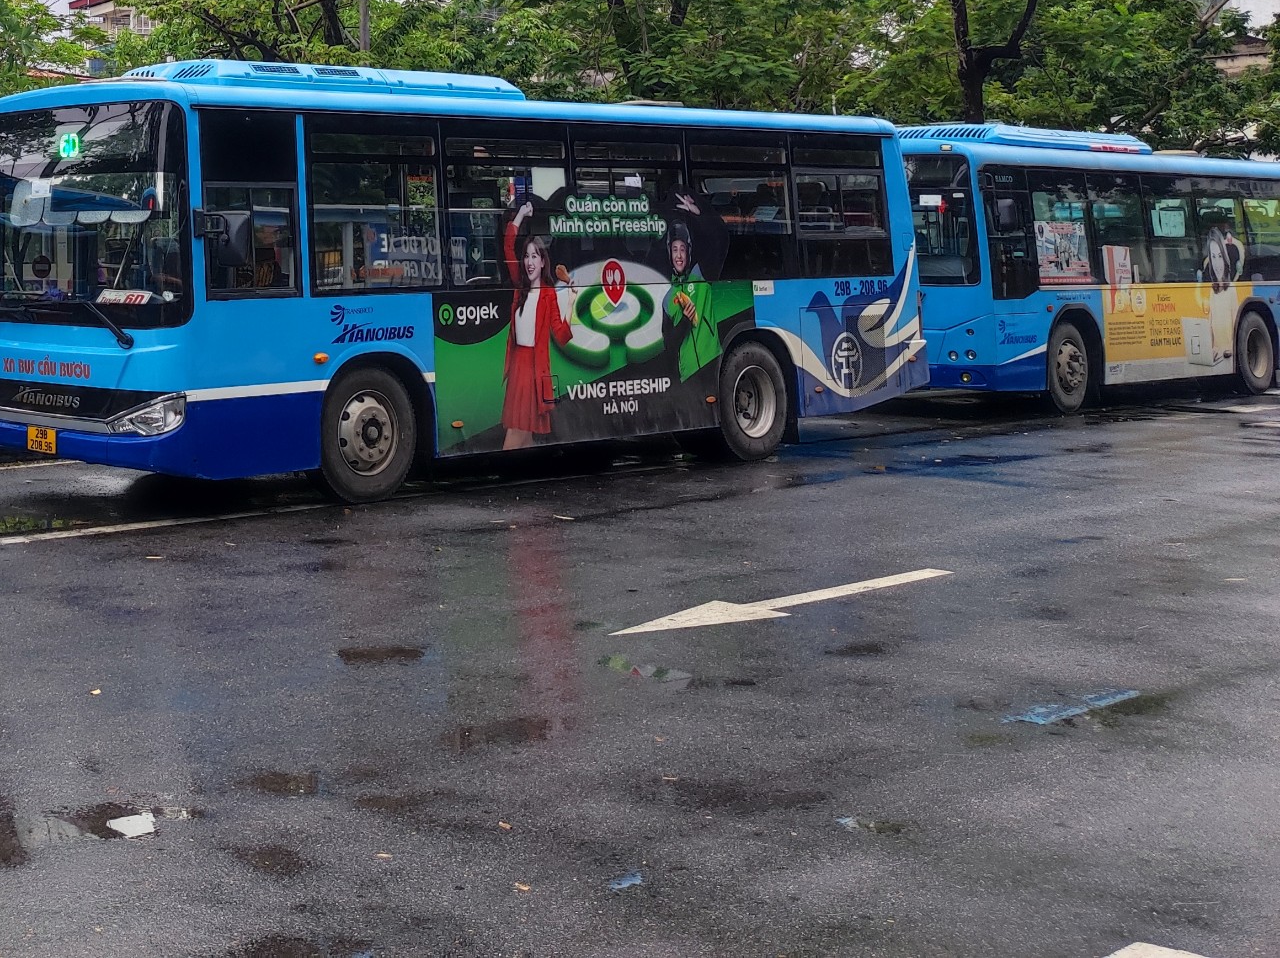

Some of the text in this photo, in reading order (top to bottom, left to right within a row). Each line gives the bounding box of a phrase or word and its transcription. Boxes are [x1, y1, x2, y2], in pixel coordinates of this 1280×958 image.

[60, 133, 79, 158] 6D
[566, 195, 649, 213] Quán còn mở
[550, 215, 667, 236] Mình còn Freeship
[834, 281, 851, 297] 29B
[859, 279, 888, 296] 208.96
[456, 302, 500, 325] gojek
[331, 322, 415, 345] HANOIBUS
[18, 359, 35, 375] BUS
[11, 385, 81, 409] HANOIBUS
[566, 377, 671, 401] VÙNG FREESHIP
[603, 397, 639, 416] HÀ NỘI
[35, 428, 48, 440] 29B
[30, 438, 53, 452] 208.96
